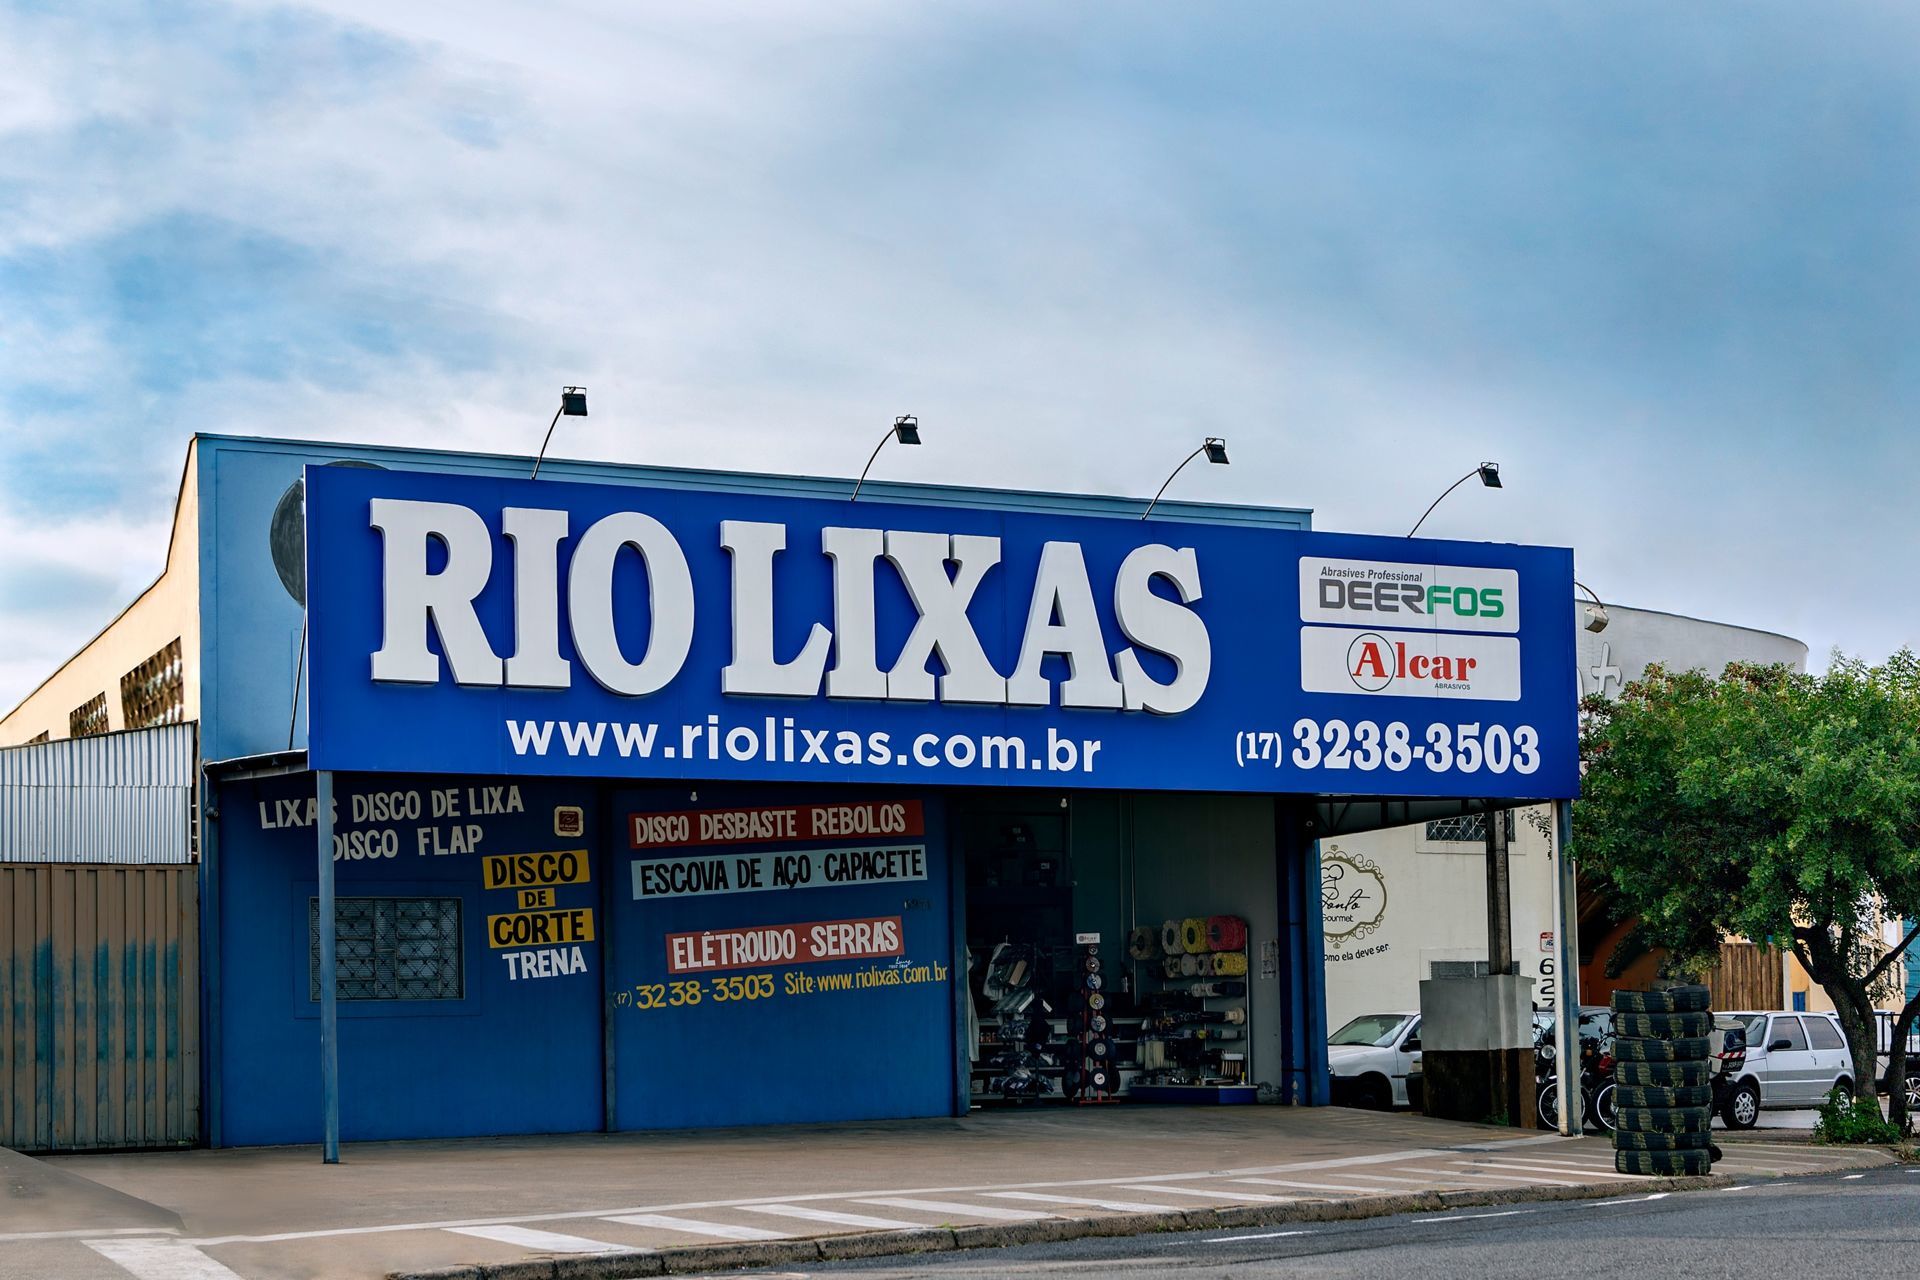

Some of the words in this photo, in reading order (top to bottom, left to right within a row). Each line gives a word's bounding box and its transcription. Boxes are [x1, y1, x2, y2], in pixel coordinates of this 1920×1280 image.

[1321, 566, 1365, 579] Abrasives
[1368, 569, 1422, 582] Professional
[369, 498, 695, 696] RIO
[719, 519, 1212, 714] LIXAS
[1319, 578, 1504, 618] DEERFOS
[1352, 641, 1477, 681] Alcar
[1434, 682, 1471, 690] ABRASIVOS
[506, 715, 1101, 773] www.riolixas.com.br
[1236, 731, 1282, 768] (17)
[1292, 718, 1541, 774] 3238-3503
[352, 790, 421, 823] DISCO
[431, 788, 461, 818] DE
[469, 785, 525, 815] LIXA
[417, 825, 483, 856] FLAP
[635, 815, 690, 845] DISCO
[700, 810, 797, 840] DESBASTE
[811, 804, 906, 836] REBOLOS
[491, 852, 579, 886] DISCO
[640, 859, 729, 895] ESCOVA
[736, 857, 763, 889] DE
[772, 854, 811, 889] AÇO
[824, 849, 923, 882] CAPACETE
[524, 891, 547, 908] DE
[493, 911, 585, 945] CORTE
[810, 920, 899, 957] SERRAS
[502, 946, 588, 980] TRENA
[1341, 952, 1354, 961] ela
[1355, 949, 1375, 959] deve
[636, 974, 775, 1009] 3238-3503
